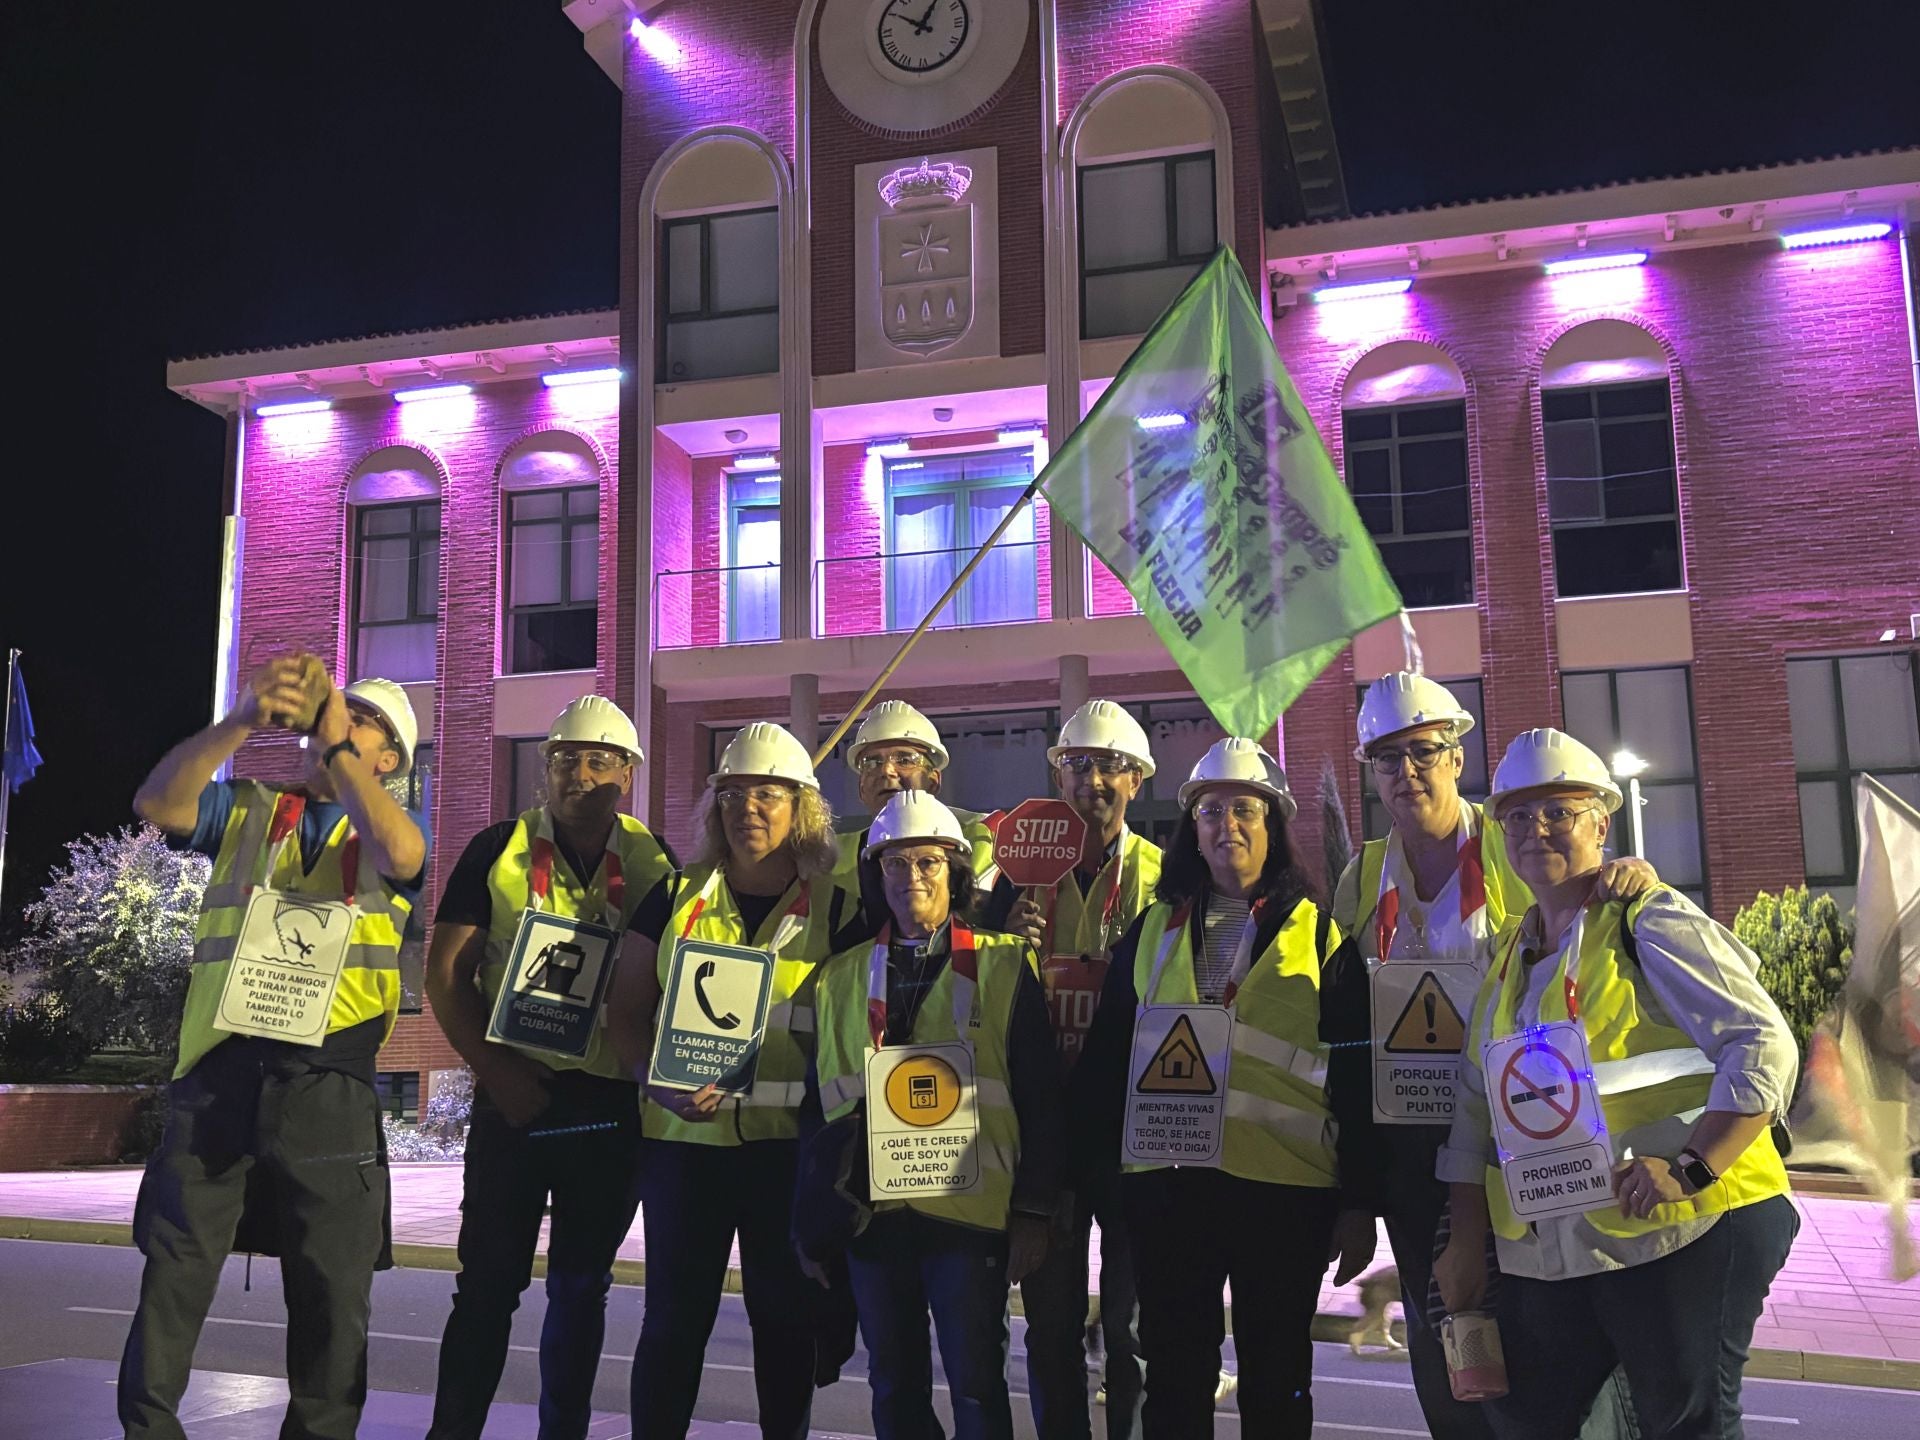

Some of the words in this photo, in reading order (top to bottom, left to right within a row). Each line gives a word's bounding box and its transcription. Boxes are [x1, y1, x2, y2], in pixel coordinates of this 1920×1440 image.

[1118, 519, 1156, 555] LA
[1146, 550, 1203, 642] FLECHA
[1013, 818, 1069, 843] STOP
[998, 845, 1077, 860] CHUPITOS
[240, 966, 254, 976] ¿Y
[268, 970, 287, 982] TUS
[288, 975, 327, 988] AMIGOS
[242, 977, 255, 987] SE
[258, 980, 287, 993] TIRAN
[289, 985, 302, 996] DE
[305, 988, 319, 998] UN
[293, 996, 306, 1008] TÚ
[245, 1001, 288, 1016] TAMBIÉN
[290, 1009, 304, 1019] LO
[512, 1000, 580, 1023] RECARGAR
[251, 1014, 292, 1028] HACES?
[519, 1016, 566, 1036] CUBATA
[671, 1034, 715, 1050] LLAMAR
[717, 1041, 747, 1054] SOLO
[675, 1048, 690, 1059] EN
[692, 1051, 722, 1064] CASO
[724, 1056, 740, 1067] DE
[686, 1063, 722, 1077] FIESTA
[1389, 1068, 1452, 1082] ¡PORQUE
[1395, 1085, 1429, 1097] DIGO
[1433, 1086, 1456, 1099] YO,
[1135, 1102, 1186, 1114] ¡MIENTRAS
[1187, 1104, 1215, 1114] VIVAS
[1147, 1115, 1173, 1125] BAJO
[1174, 1116, 1200, 1126] ESTE
[1134, 1128, 1168, 1139] TECHO,
[1169, 1129, 1183, 1138] SE
[1184, 1130, 1212, 1140] HACE
[880, 1136, 911, 1150] ¿QUÉ
[913, 1137, 928, 1147] TE
[930, 1135, 968, 1146] CREES
[1132, 1141, 1145, 1150] LO
[1147, 1141, 1167, 1151] QUE
[1168, 1142, 1182, 1152] YO
[1184, 1143, 1211, 1153] DIGA!
[891, 1151, 915, 1161] QUE
[917, 1149, 941, 1160] SOY
[943, 1149, 959, 1159] UN
[903, 1162, 949, 1174] CAJERO
[1522, 1158, 1593, 1183] PROHIBIDO
[886, 1174, 967, 1188] AUTOMÁTICO?
[1519, 1183, 1564, 1202] FUMAR
[1566, 1180, 1588, 1194] SIN
[1591, 1175, 1606, 1189] MI
